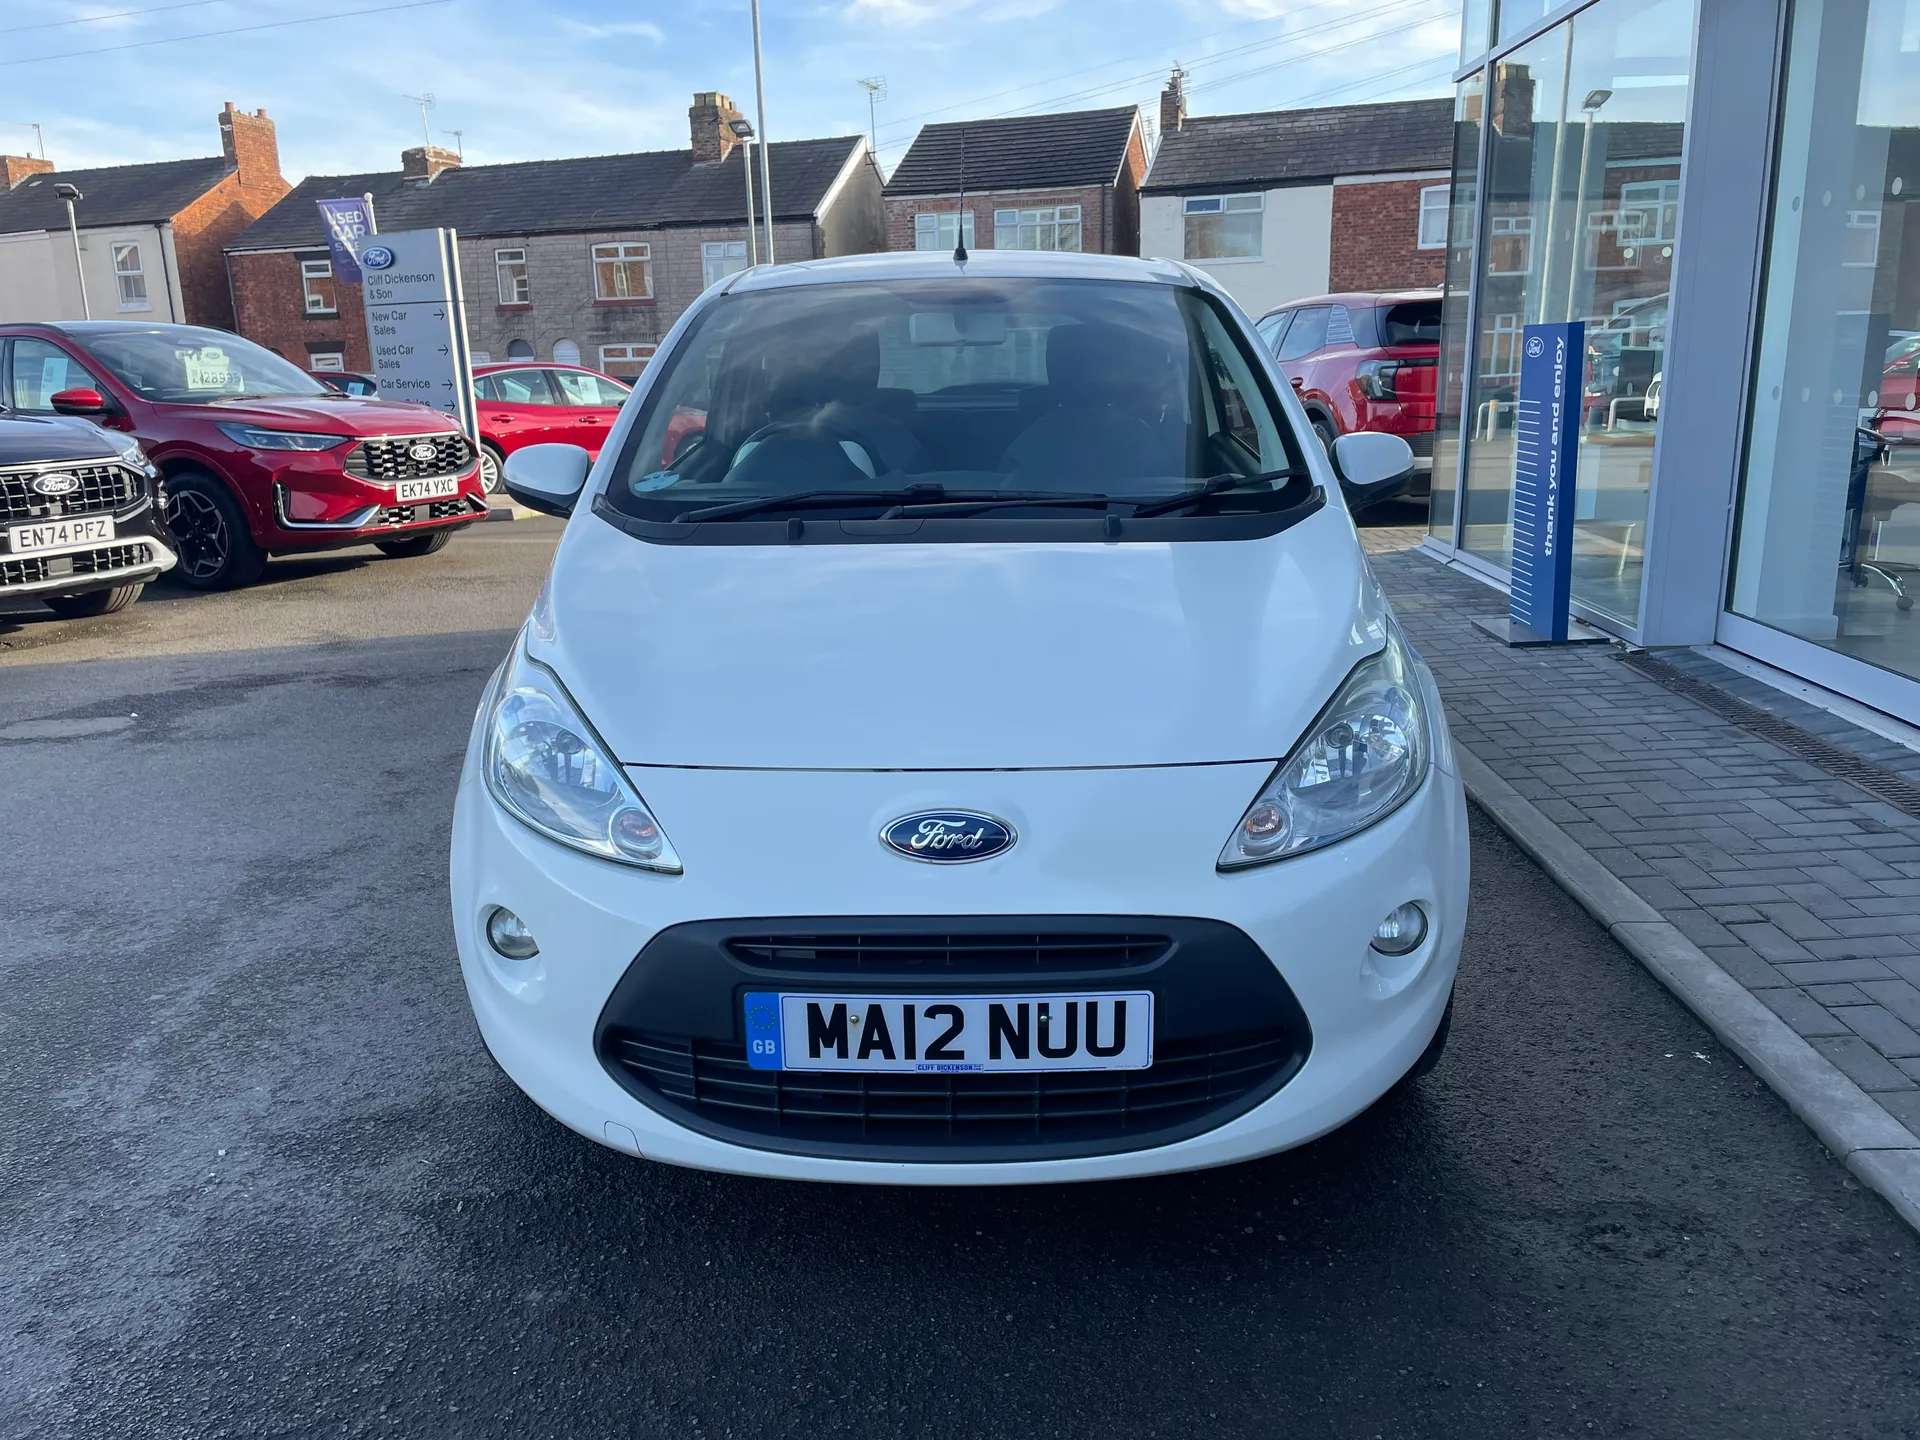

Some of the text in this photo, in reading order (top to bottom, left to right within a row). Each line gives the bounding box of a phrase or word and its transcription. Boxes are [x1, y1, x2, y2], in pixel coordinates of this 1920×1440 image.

[331, 224, 366, 240] CAR
[367, 273, 435, 286] Cliff Dickenson
[376, 288, 393, 299] Son
[372, 310, 407, 321] New Car
[374, 325, 396, 335] Sales
[376, 344, 414, 355] Used Car
[378, 359, 400, 369] Sales
[381, 378, 431, 389] Car Service
[1544, 336, 1565, 557] thank you and enjoy
[401, 479, 454, 498] EK74 YXC
[20, 520, 108, 548] EN74 PFZ
[910, 819, 985, 849] Ford
[807, 1000, 1127, 1061] MA12 NUU
[752, 1040, 776, 1055] GB
